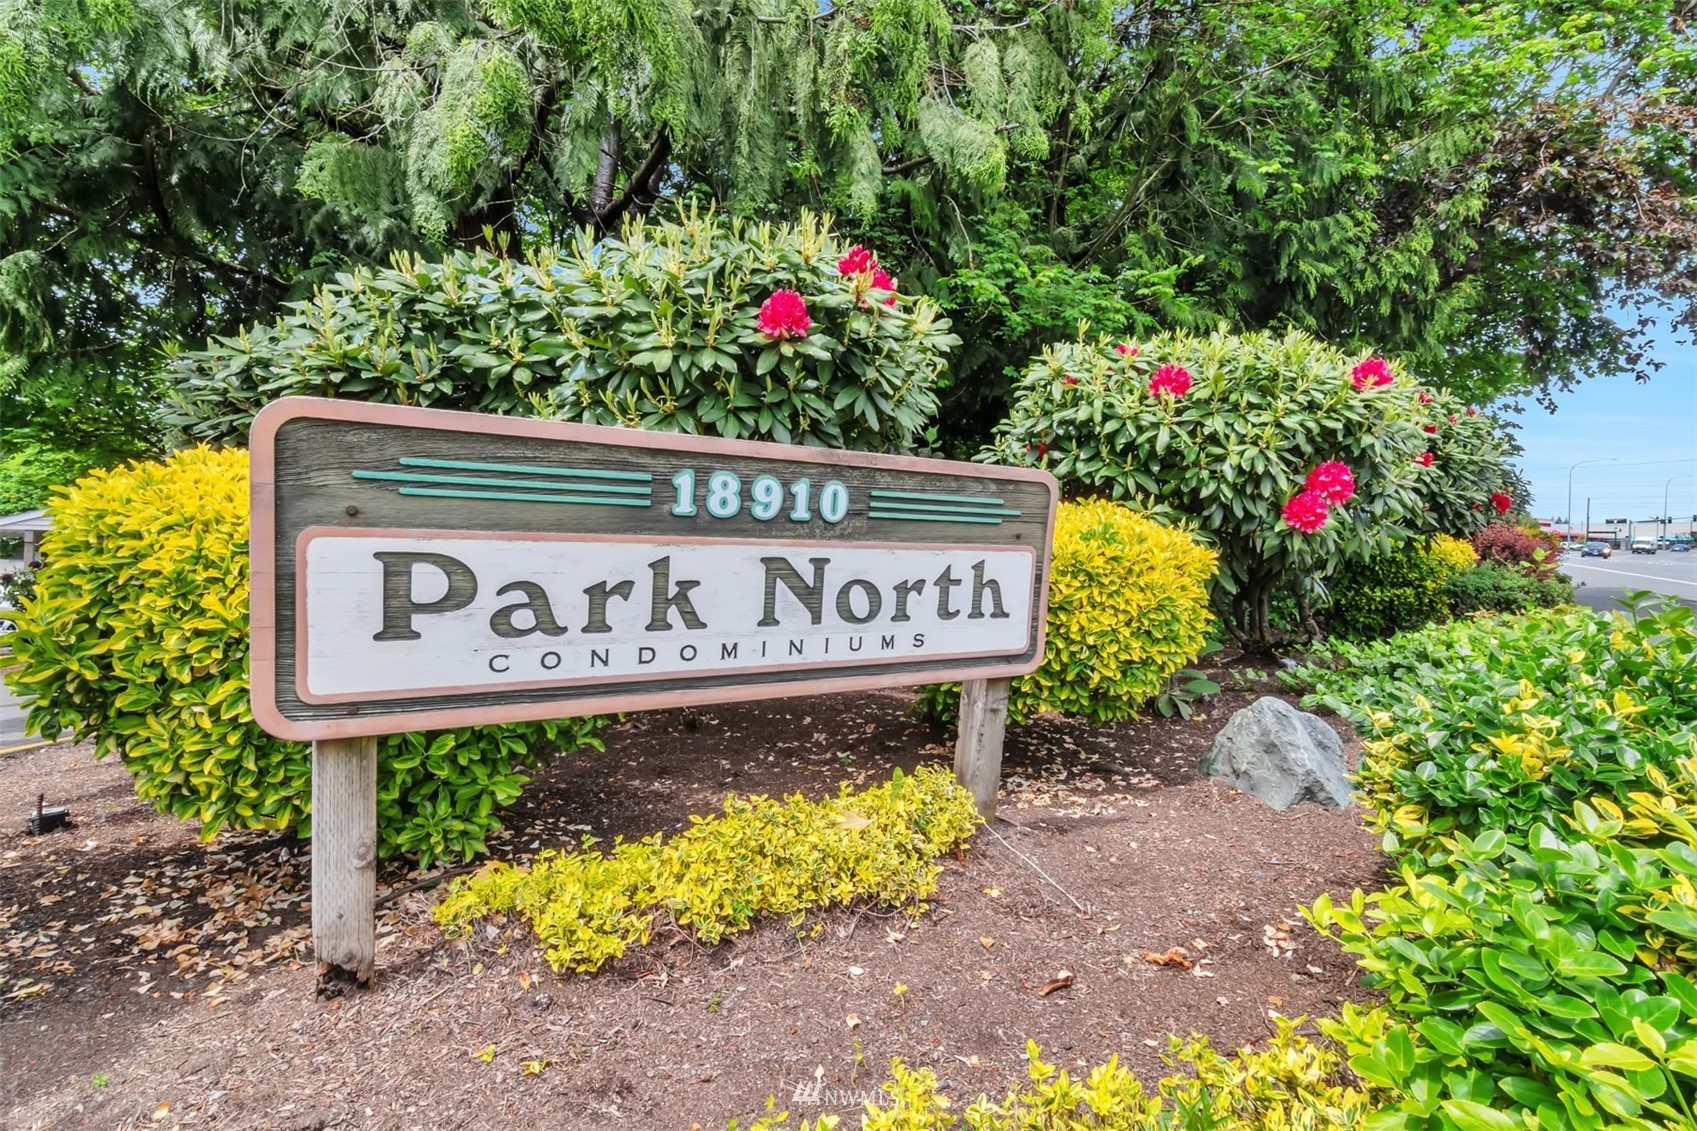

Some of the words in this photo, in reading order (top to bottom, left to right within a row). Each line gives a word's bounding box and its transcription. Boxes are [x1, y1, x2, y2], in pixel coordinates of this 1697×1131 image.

[672, 469, 849, 523] 18910
[372, 551, 707, 641] Park
[757, 557, 1010, 627] North
[488, 633, 925, 673] CONDOMINIUMS
